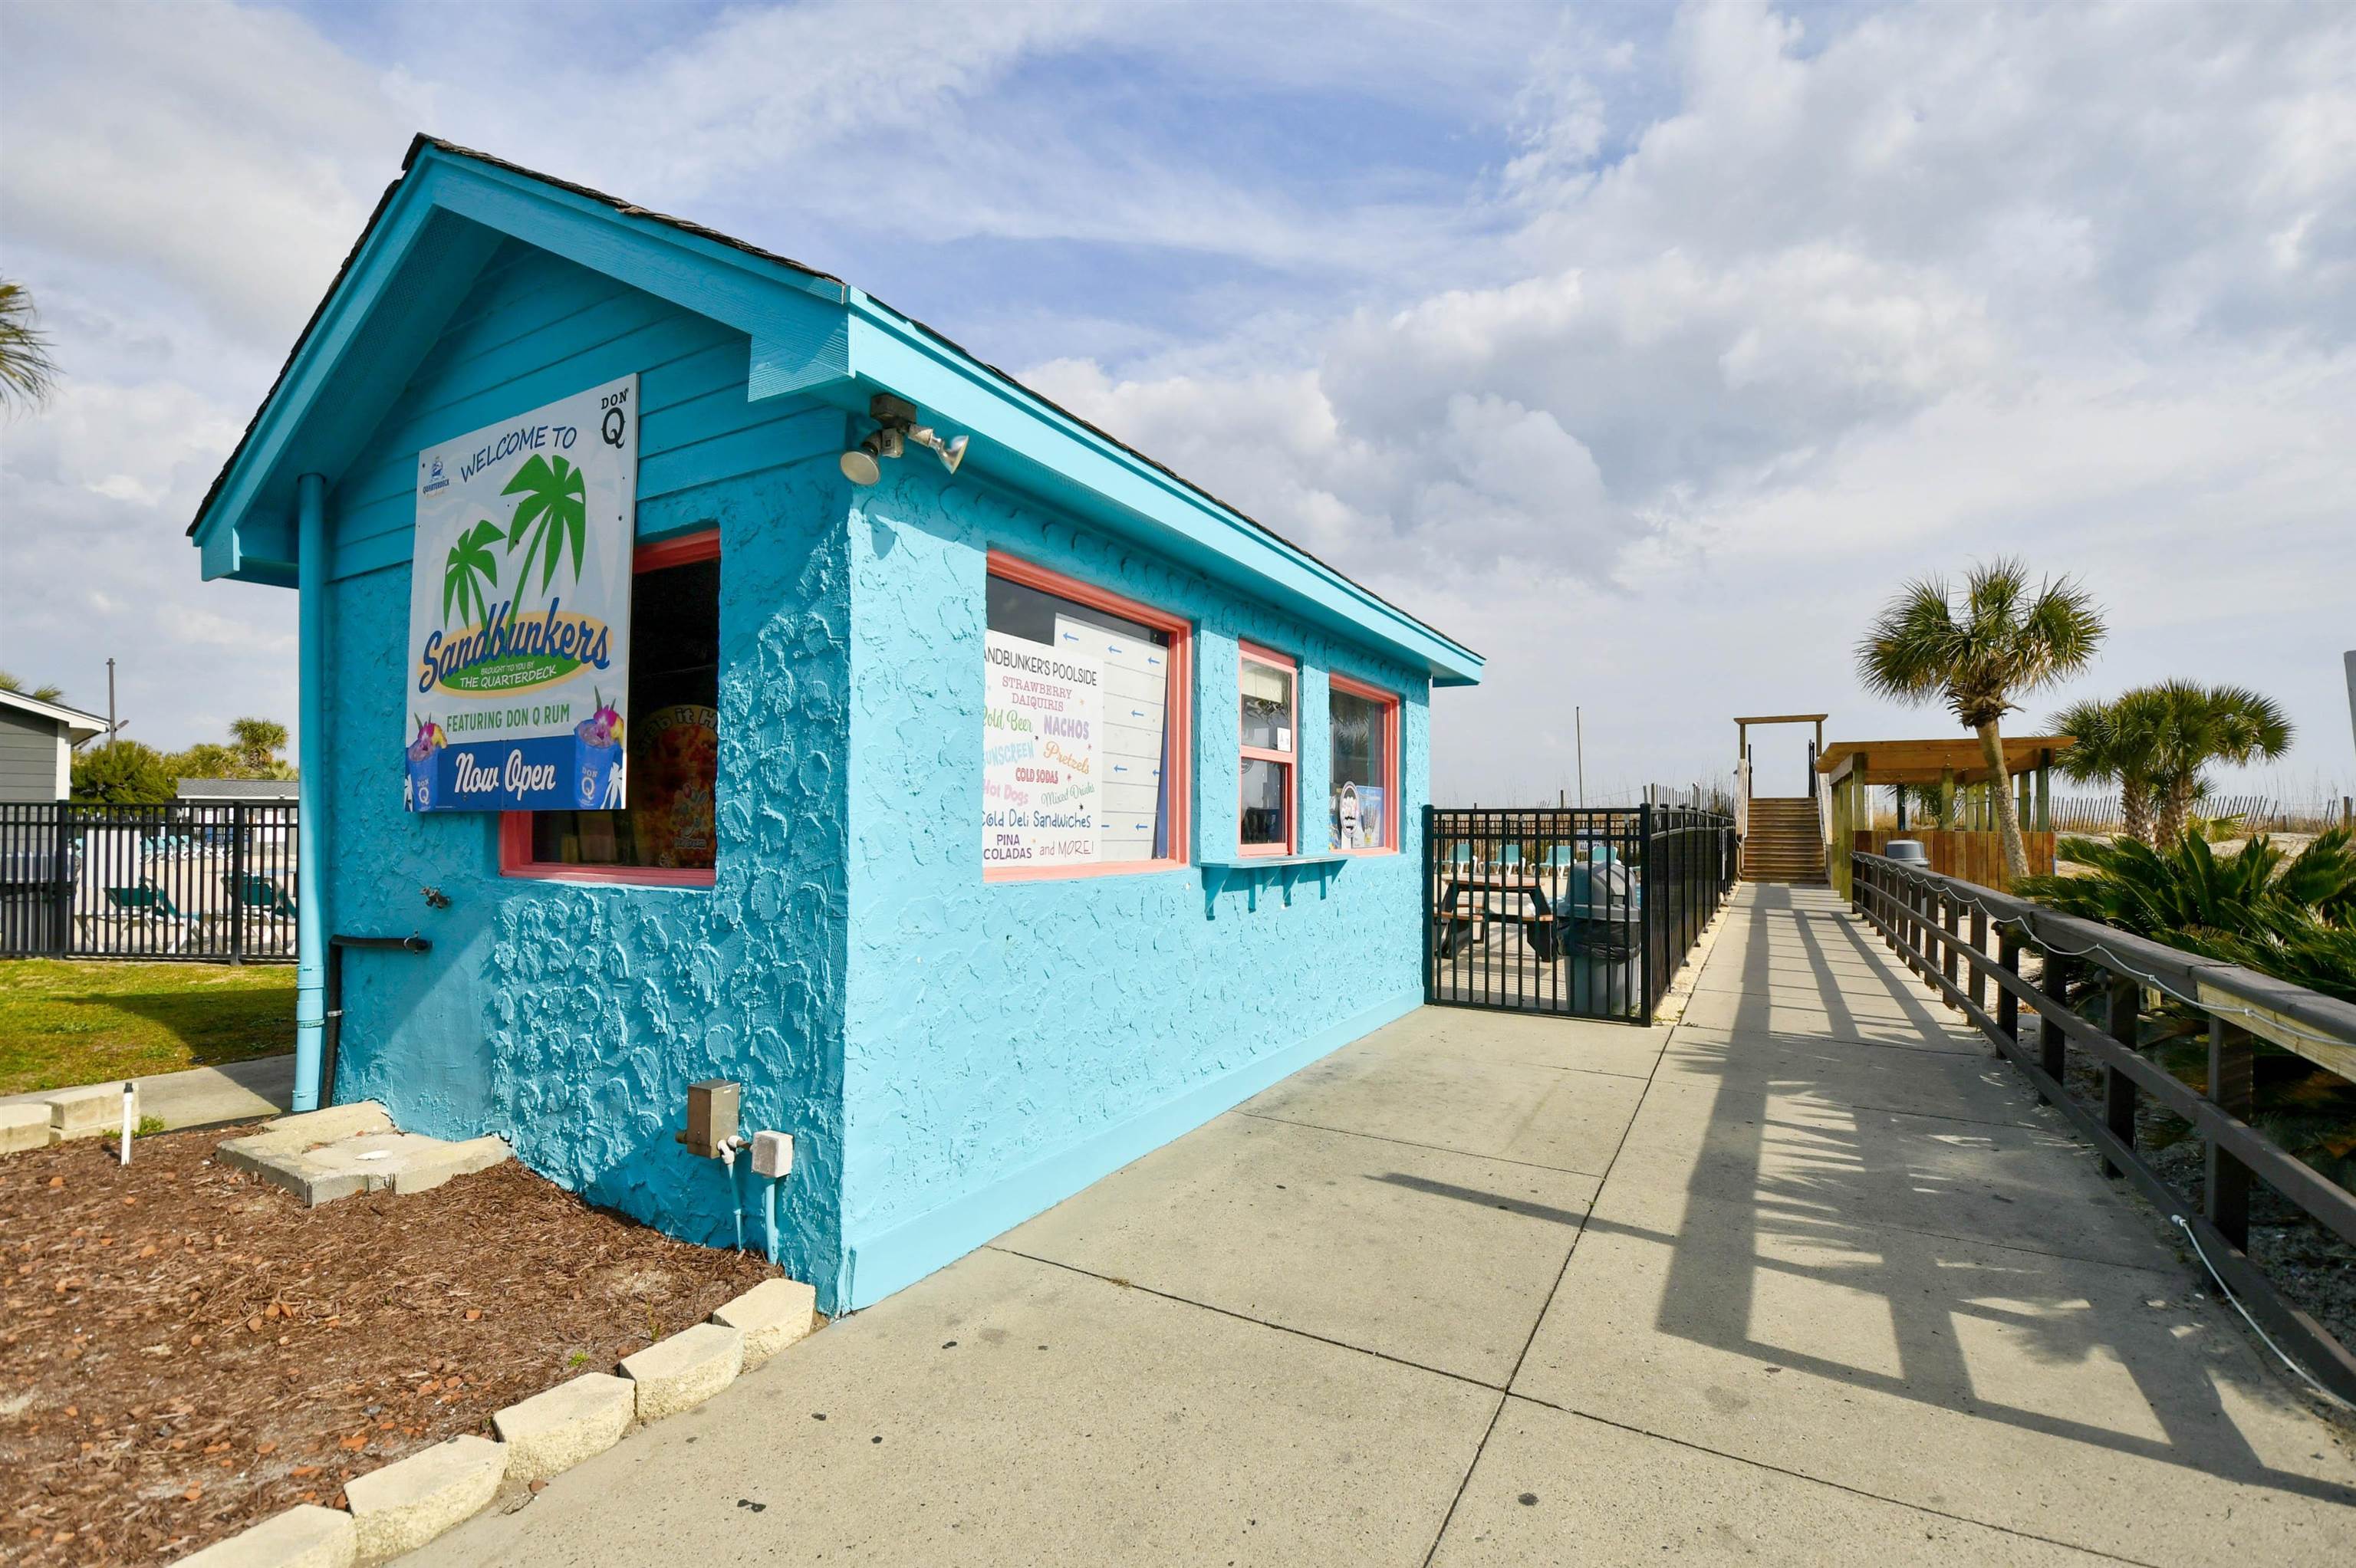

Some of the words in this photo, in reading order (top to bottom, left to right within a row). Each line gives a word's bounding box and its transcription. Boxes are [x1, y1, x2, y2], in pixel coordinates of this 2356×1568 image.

[601, 407, 626, 449] Q
[461, 426, 548, 482] WELCOME
[552, 426, 577, 449] TO
[419, 597, 610, 692] Sandbunkers
[460, 676, 479, 687] THE
[480, 665, 557, 689] QUARTERDECK
[481, 665, 505, 675] BROUGHT
[1053, 662, 1097, 685] POOLSIDE
[1002, 676, 1072, 699] STRAWBERRY
[1012, 693, 1064, 712] DAIQUIRIS
[446, 711, 502, 732] FEATURING
[507, 708, 528, 728] DON
[533, 707, 540, 726] Q
[545, 703, 570, 724] RUM
[675, 707, 694, 725] it
[1006, 709, 1033, 733] Beer
[1044, 715, 1089, 740] NACHOS
[984, 740, 1035, 767] UNSCREEN
[1043, 741, 1089, 774] Pretzels
[454, 752, 499, 793] Now
[505, 749, 556, 801] Open
[1015, 768, 1035, 782] COLD
[1036, 769, 1059, 784] SODAS
[419, 787, 429, 804] Q
[581, 776, 595, 800] Q
[982, 779, 1000, 797] Hot
[1004, 784, 1029, 807] Dogs
[1041, 788, 1068, 807] Mixed
[1070, 782, 1095, 799] Drinks
[1009, 808, 1029, 827] Deli
[996, 834, 1020, 846] PINA
[1039, 841, 1055, 856] and
[1058, 840, 1094, 857] MORE!
[983, 847, 1032, 860] COLADAS
